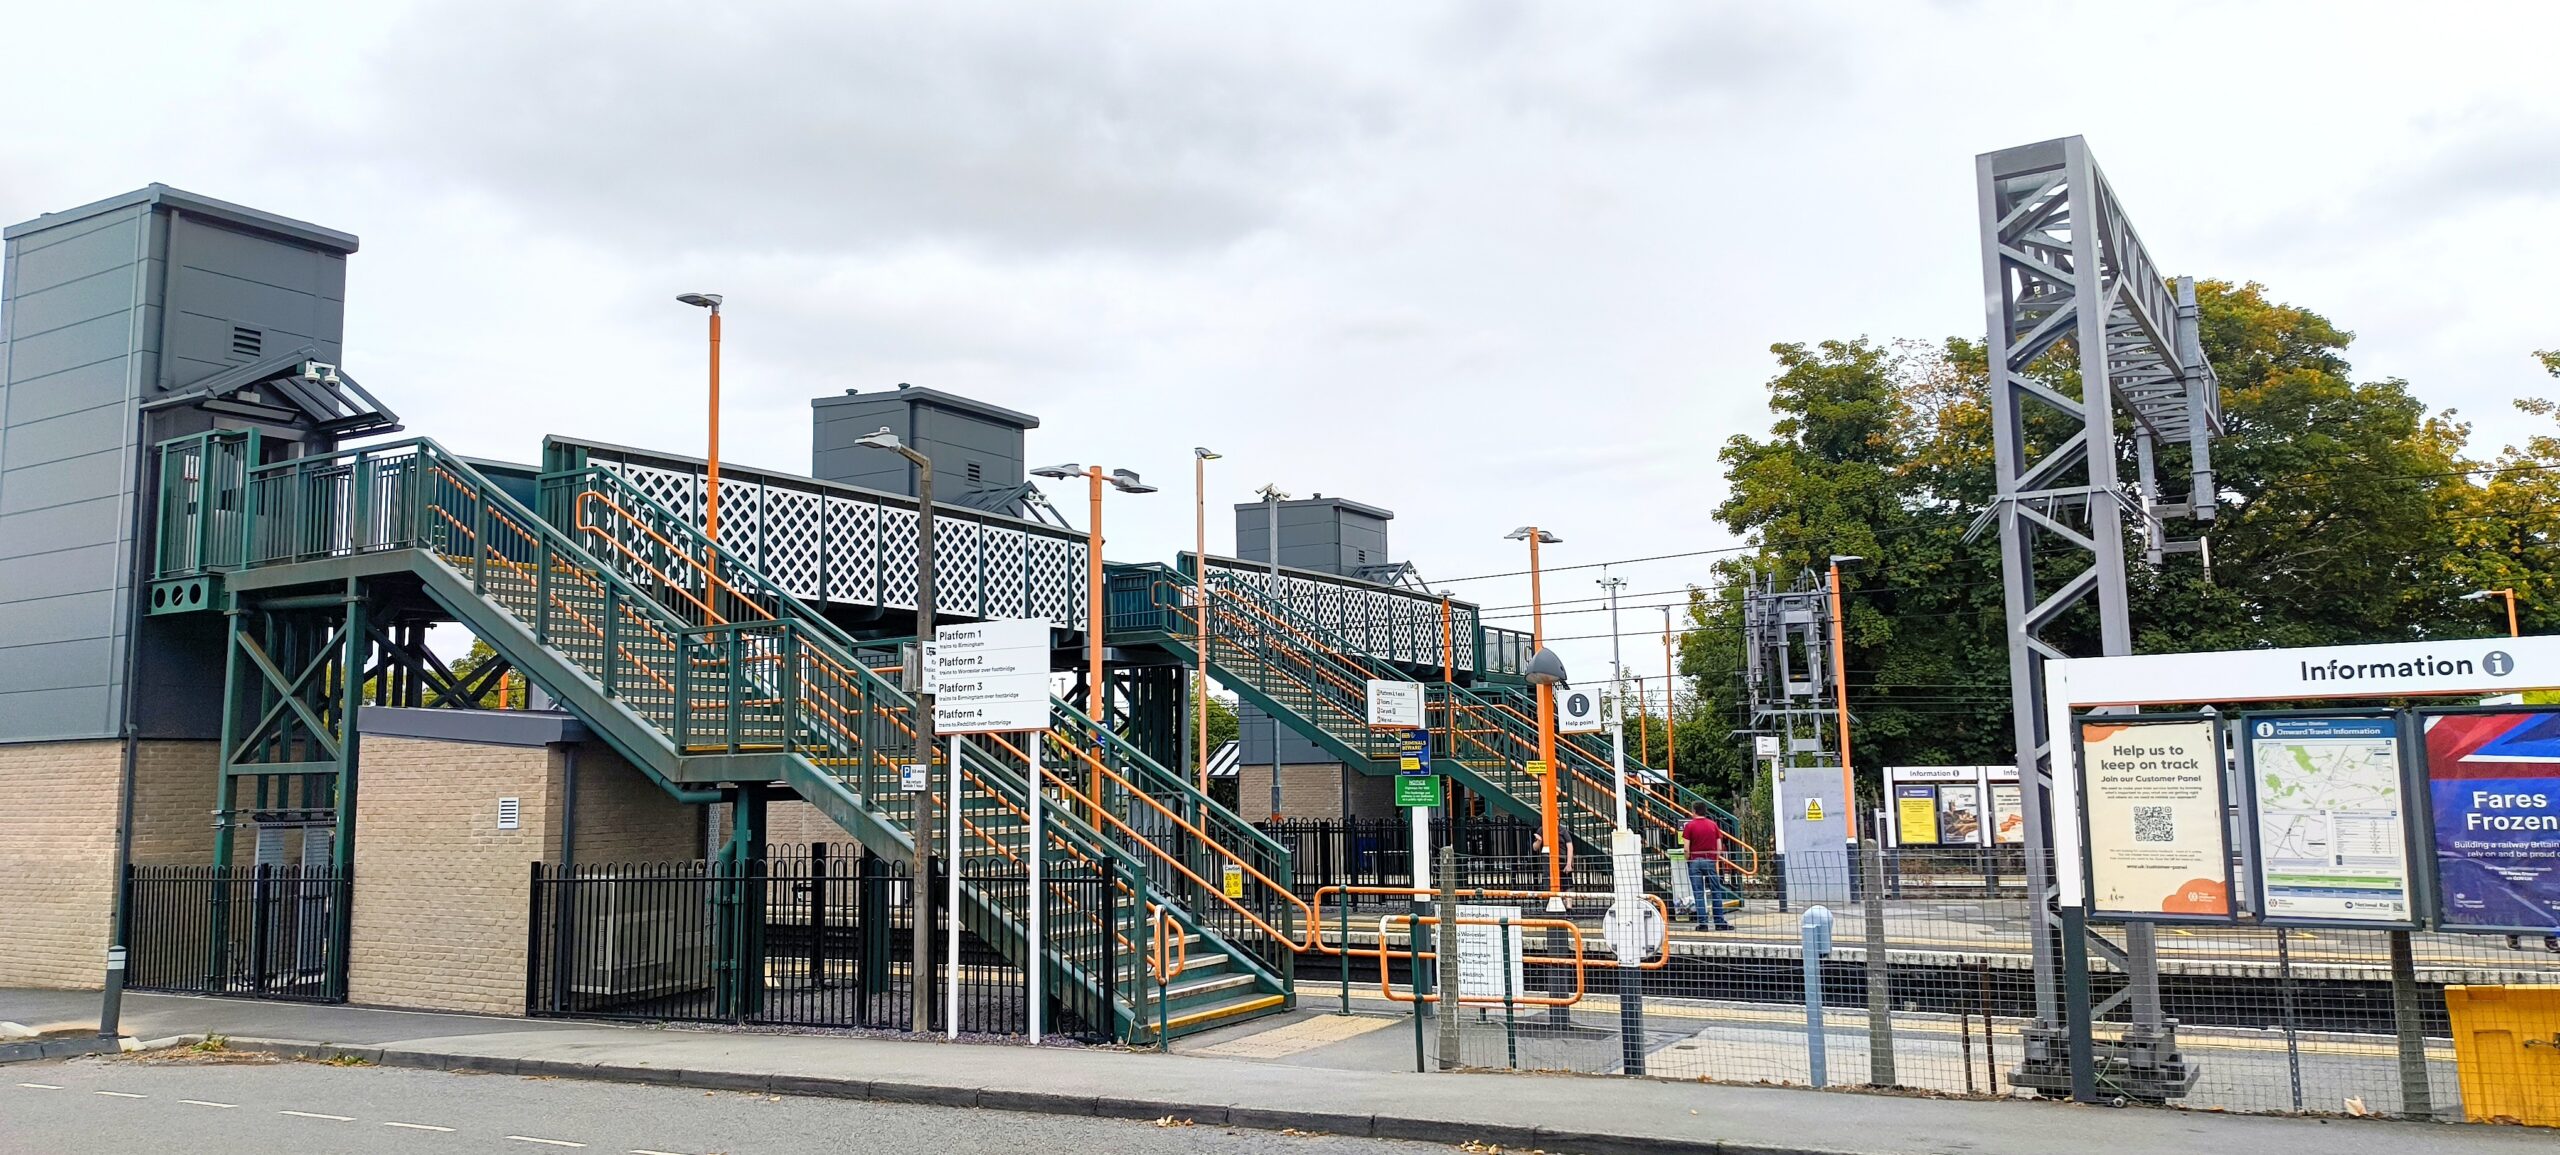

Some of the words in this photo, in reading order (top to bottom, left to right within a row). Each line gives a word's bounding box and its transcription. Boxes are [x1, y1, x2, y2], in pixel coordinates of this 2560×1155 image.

[940, 630, 976, 640] Platform
[978, 630, 982, 638] 1
[939, 657, 975, 667] Platform
[977, 656, 983, 665] 2
[2301, 655, 2473, 680] Information
[939, 683, 975, 693] Platform
[977, 682, 982, 690] 3
[939, 709, 974, 719] Platform
[2113, 745, 2144, 758] Help
[2149, 747, 2165, 756] us
[2170, 746, 2184, 755] to
[2101, 760, 2135, 772] keep
[2140, 761, 2157, 770] on
[2161, 759, 2198, 769] track
[2472, 791, 2547, 808] Fares
[2467, 813, 2558, 830] Frozen
